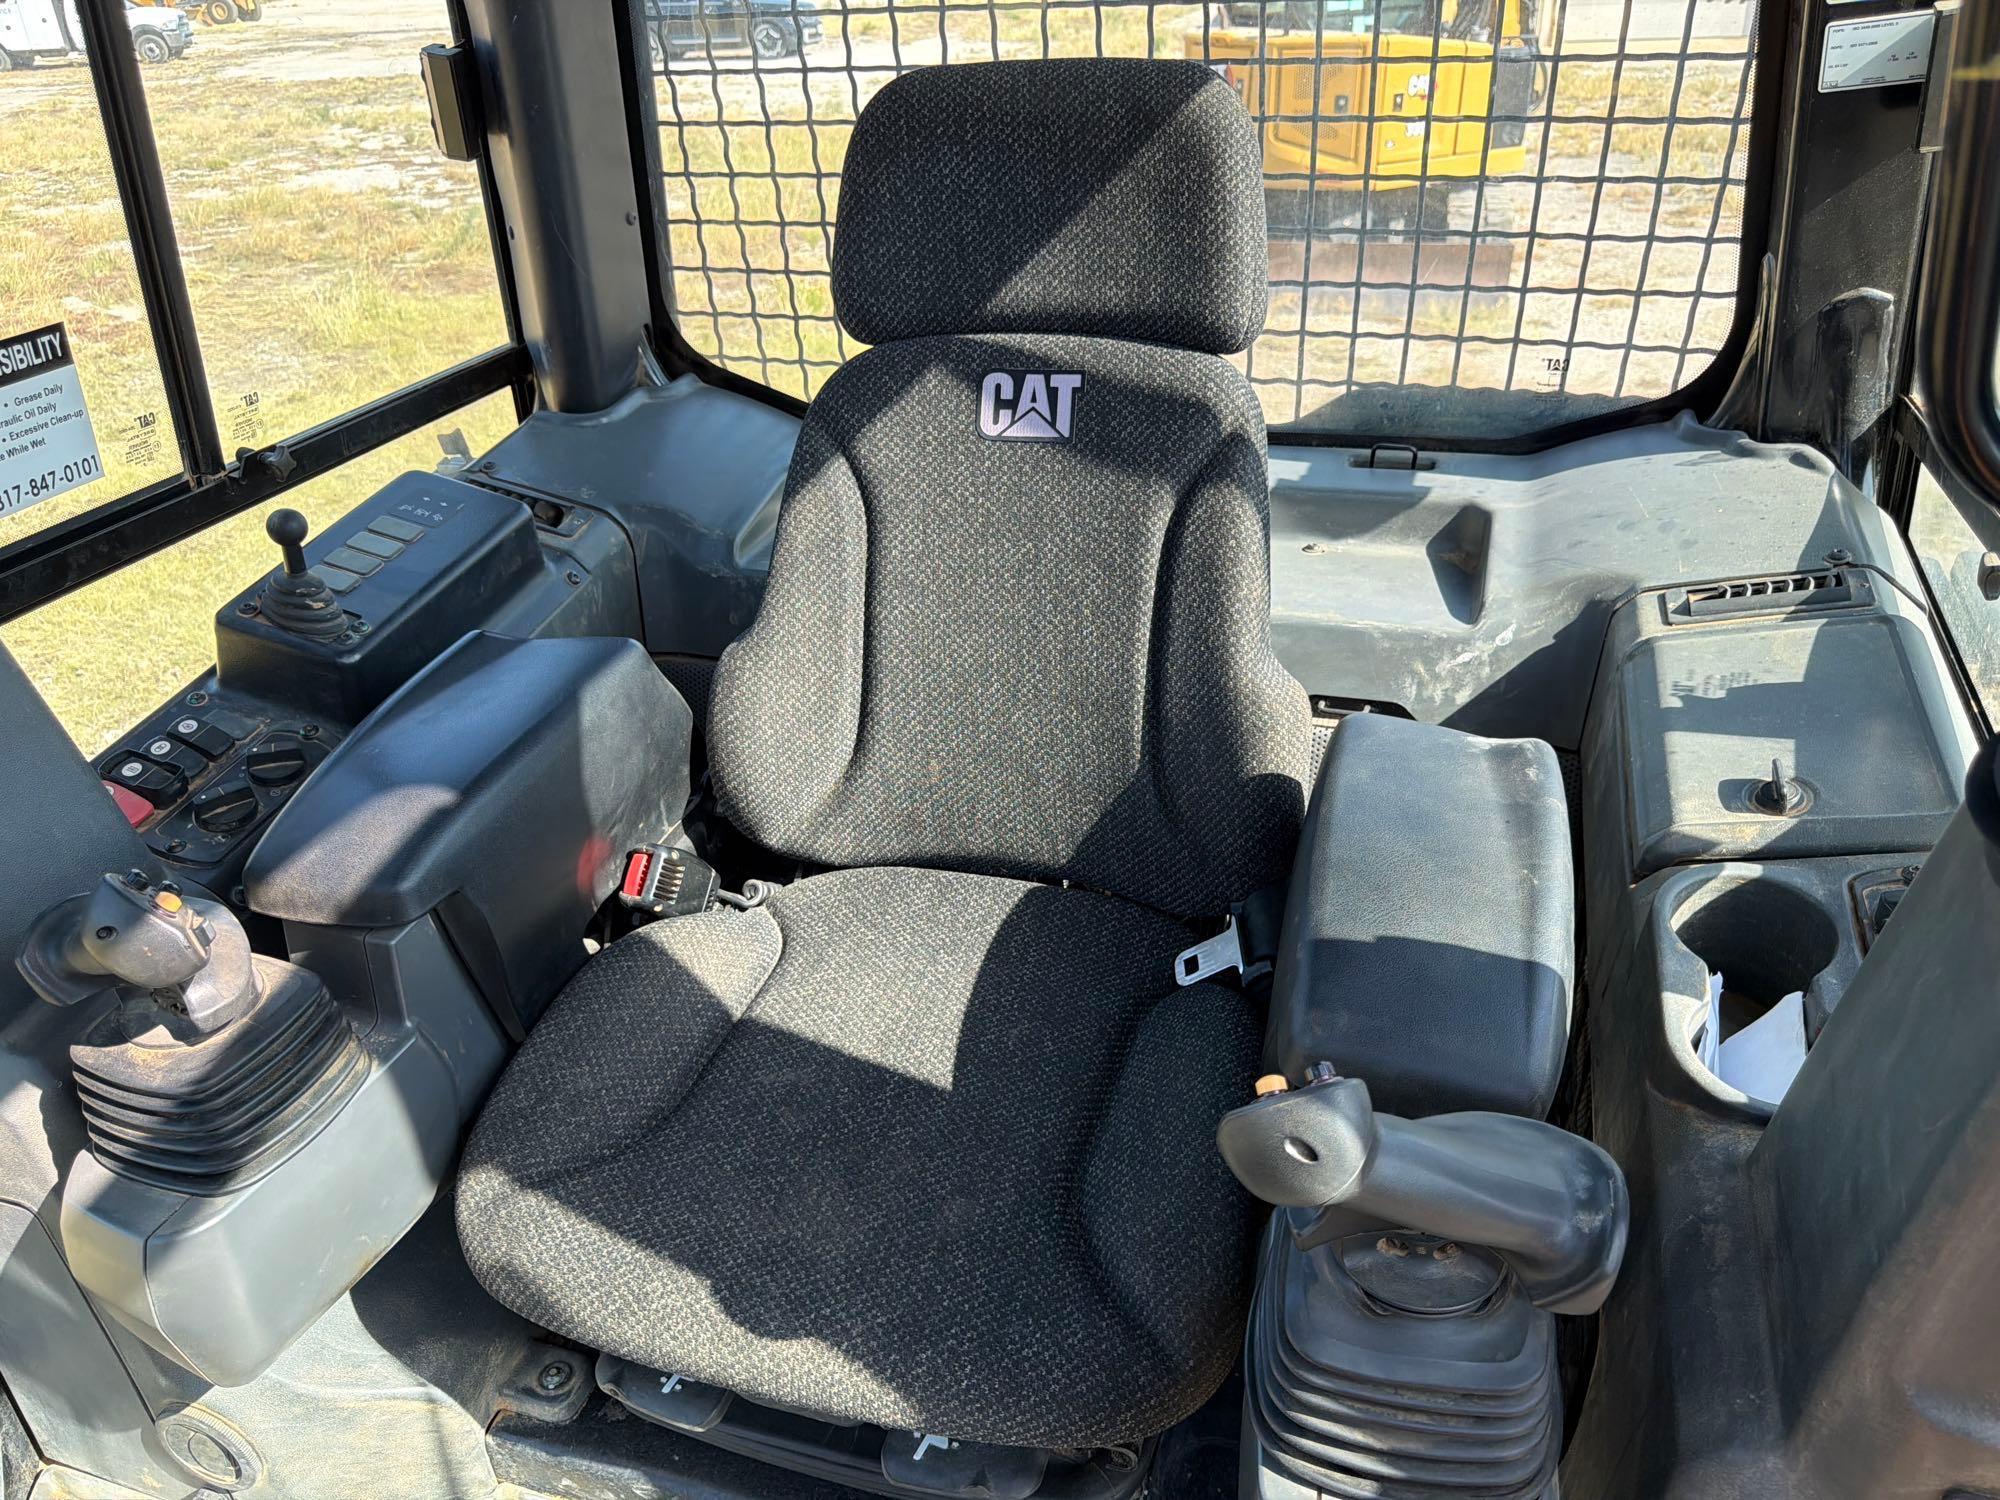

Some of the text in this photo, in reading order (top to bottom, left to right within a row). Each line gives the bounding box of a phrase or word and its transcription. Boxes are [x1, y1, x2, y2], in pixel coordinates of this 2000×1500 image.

[0, 332, 62, 376] SIBILITY
[14, 384, 63, 406] Grease Daily
[980, 372, 1082, 438] CAT
[0, 402, 57, 429] raulic Oil Daily
[9, 409, 84, 441] Excessive Clean-up
[6, 444, 29, 458] While
[29, 437, 46, 449] Wet
